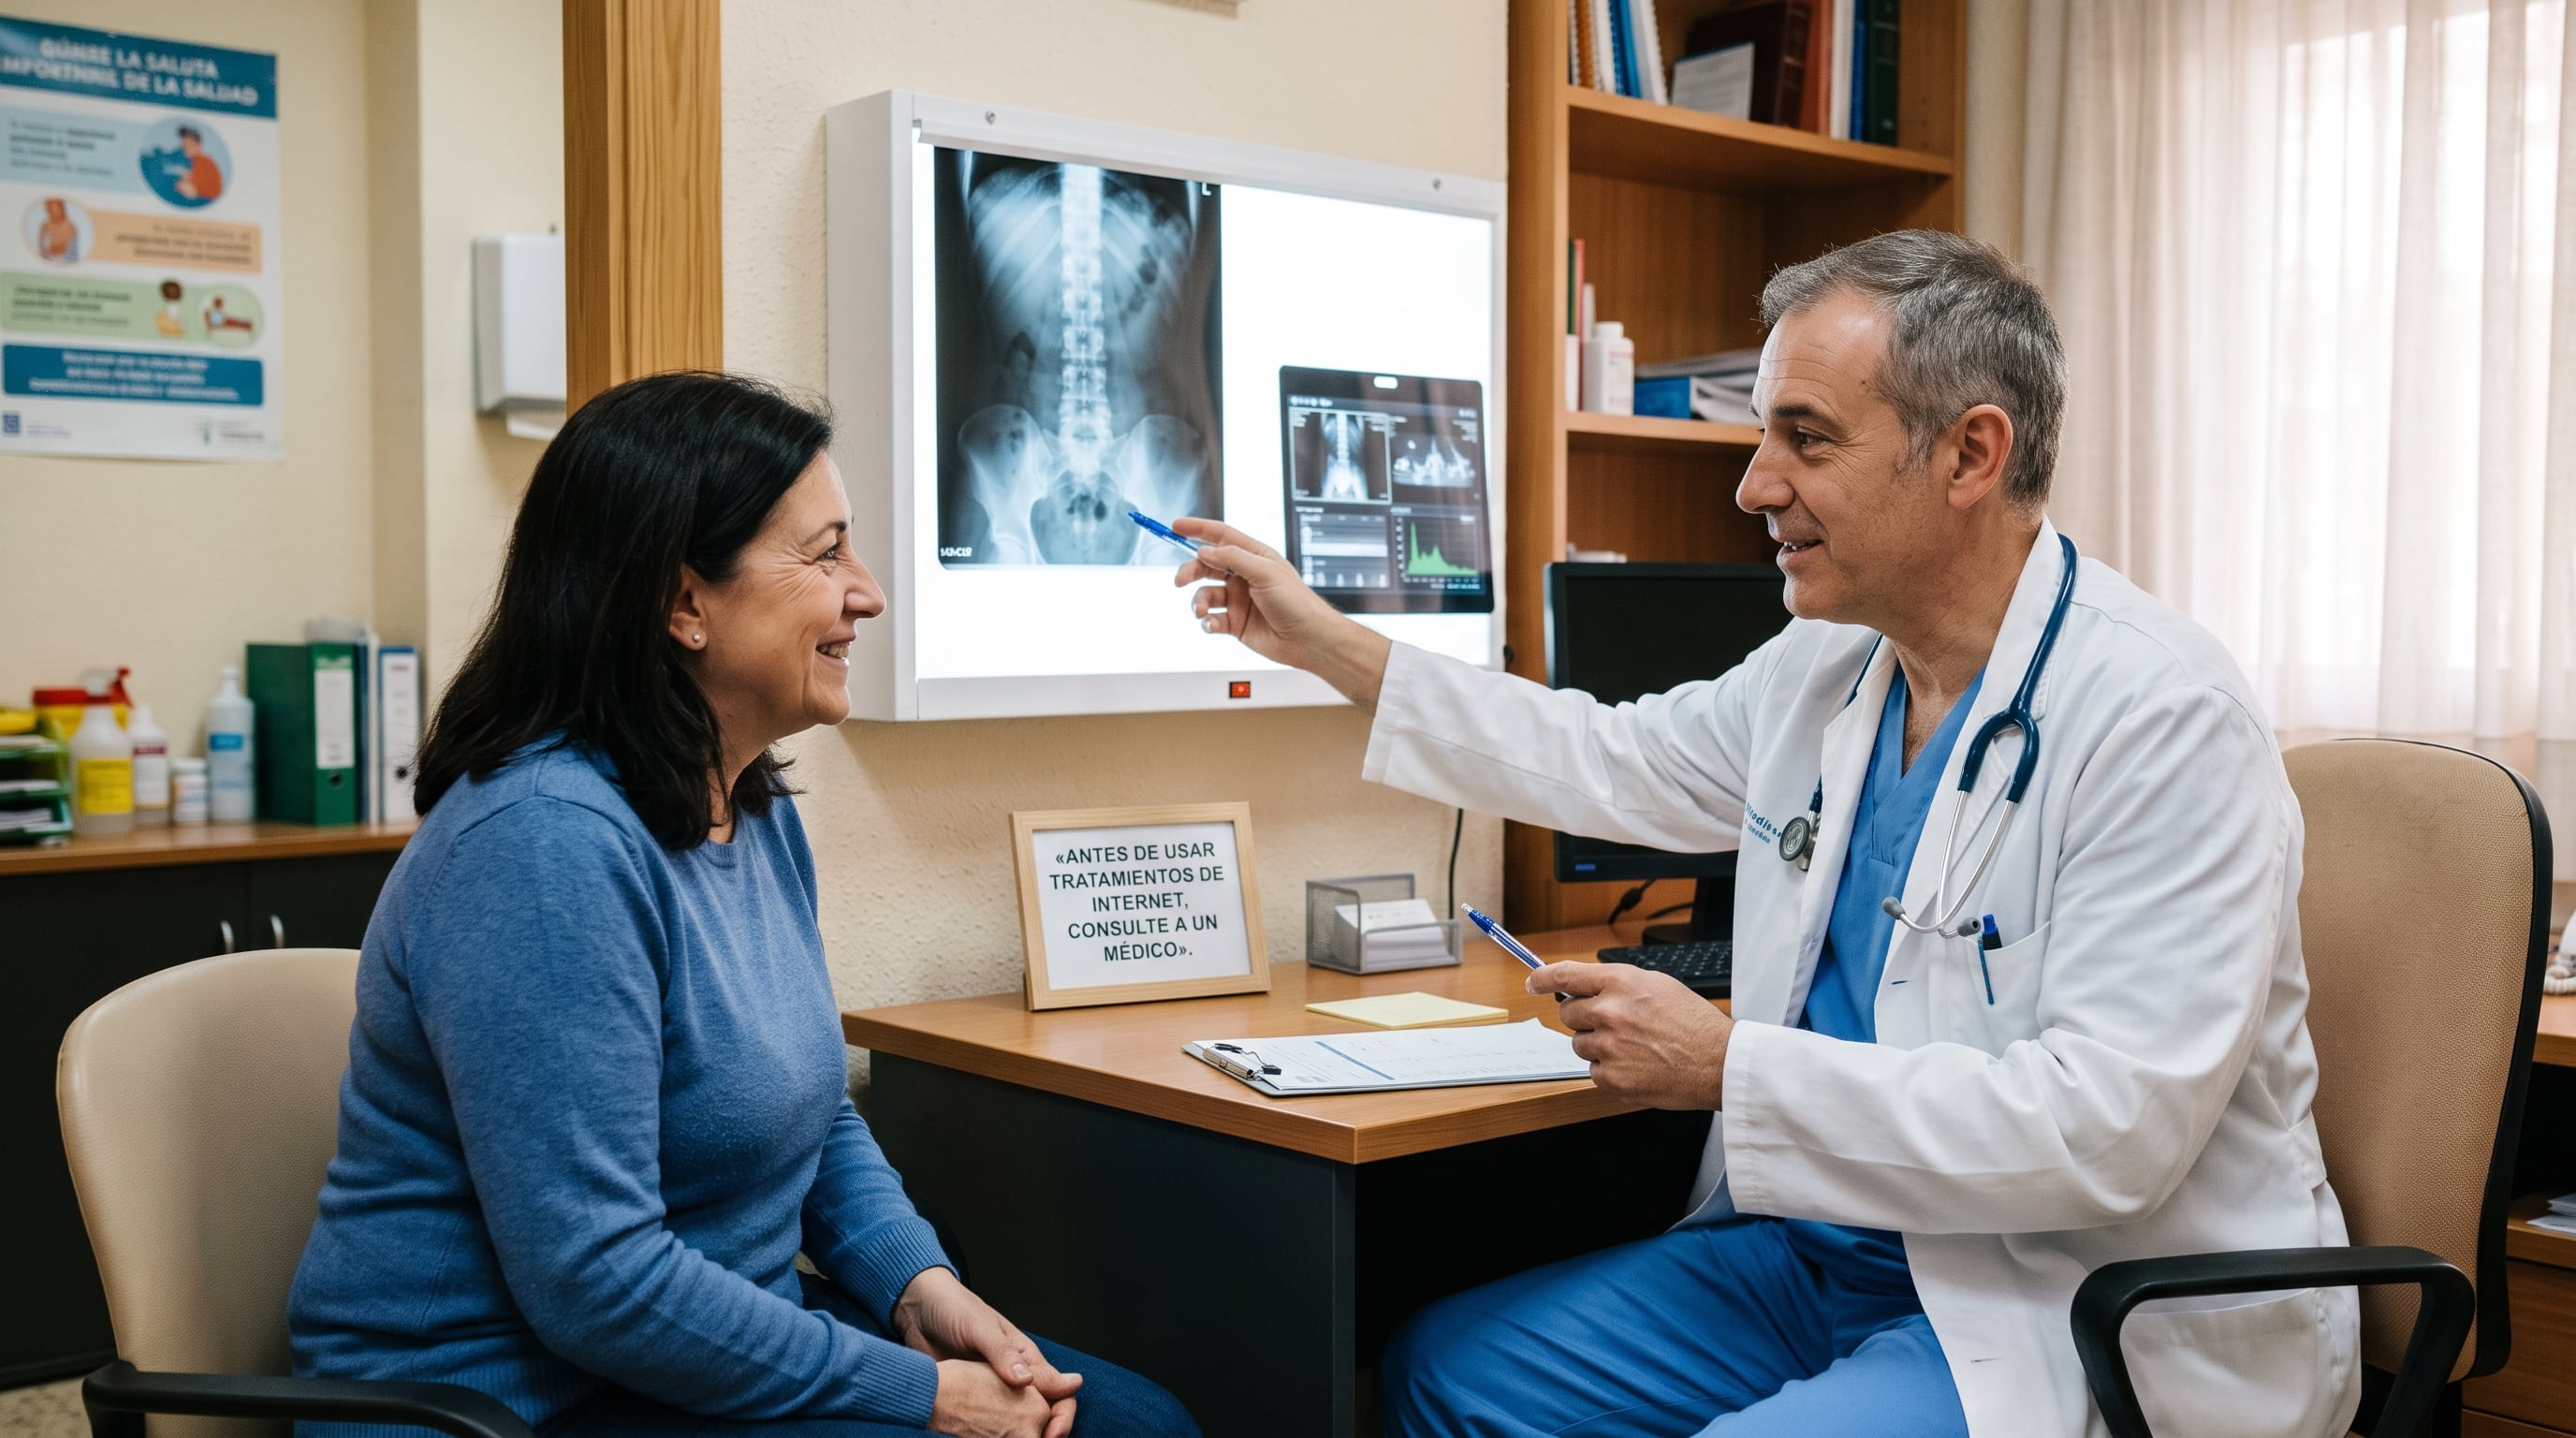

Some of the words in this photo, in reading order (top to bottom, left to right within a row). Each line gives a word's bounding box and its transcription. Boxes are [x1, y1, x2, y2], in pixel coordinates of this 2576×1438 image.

[1202, 183, 1211, 196] L
[1055, 845, 1129, 864] «ANTES
[1134, 844, 1160, 861] DE
[1164, 842, 1215, 859] USAR
[1049, 867, 1194, 890] TRATAMIENTOS
[1199, 865, 1224, 882] DE
[1092, 891, 1189, 913] INTERNET,
[1068, 917, 1169, 939] CONSULTE
[1175, 917, 1188, 932] A
[1192, 914, 1218, 932] UN
[1104, 940, 1193, 962] MÉDICO».
